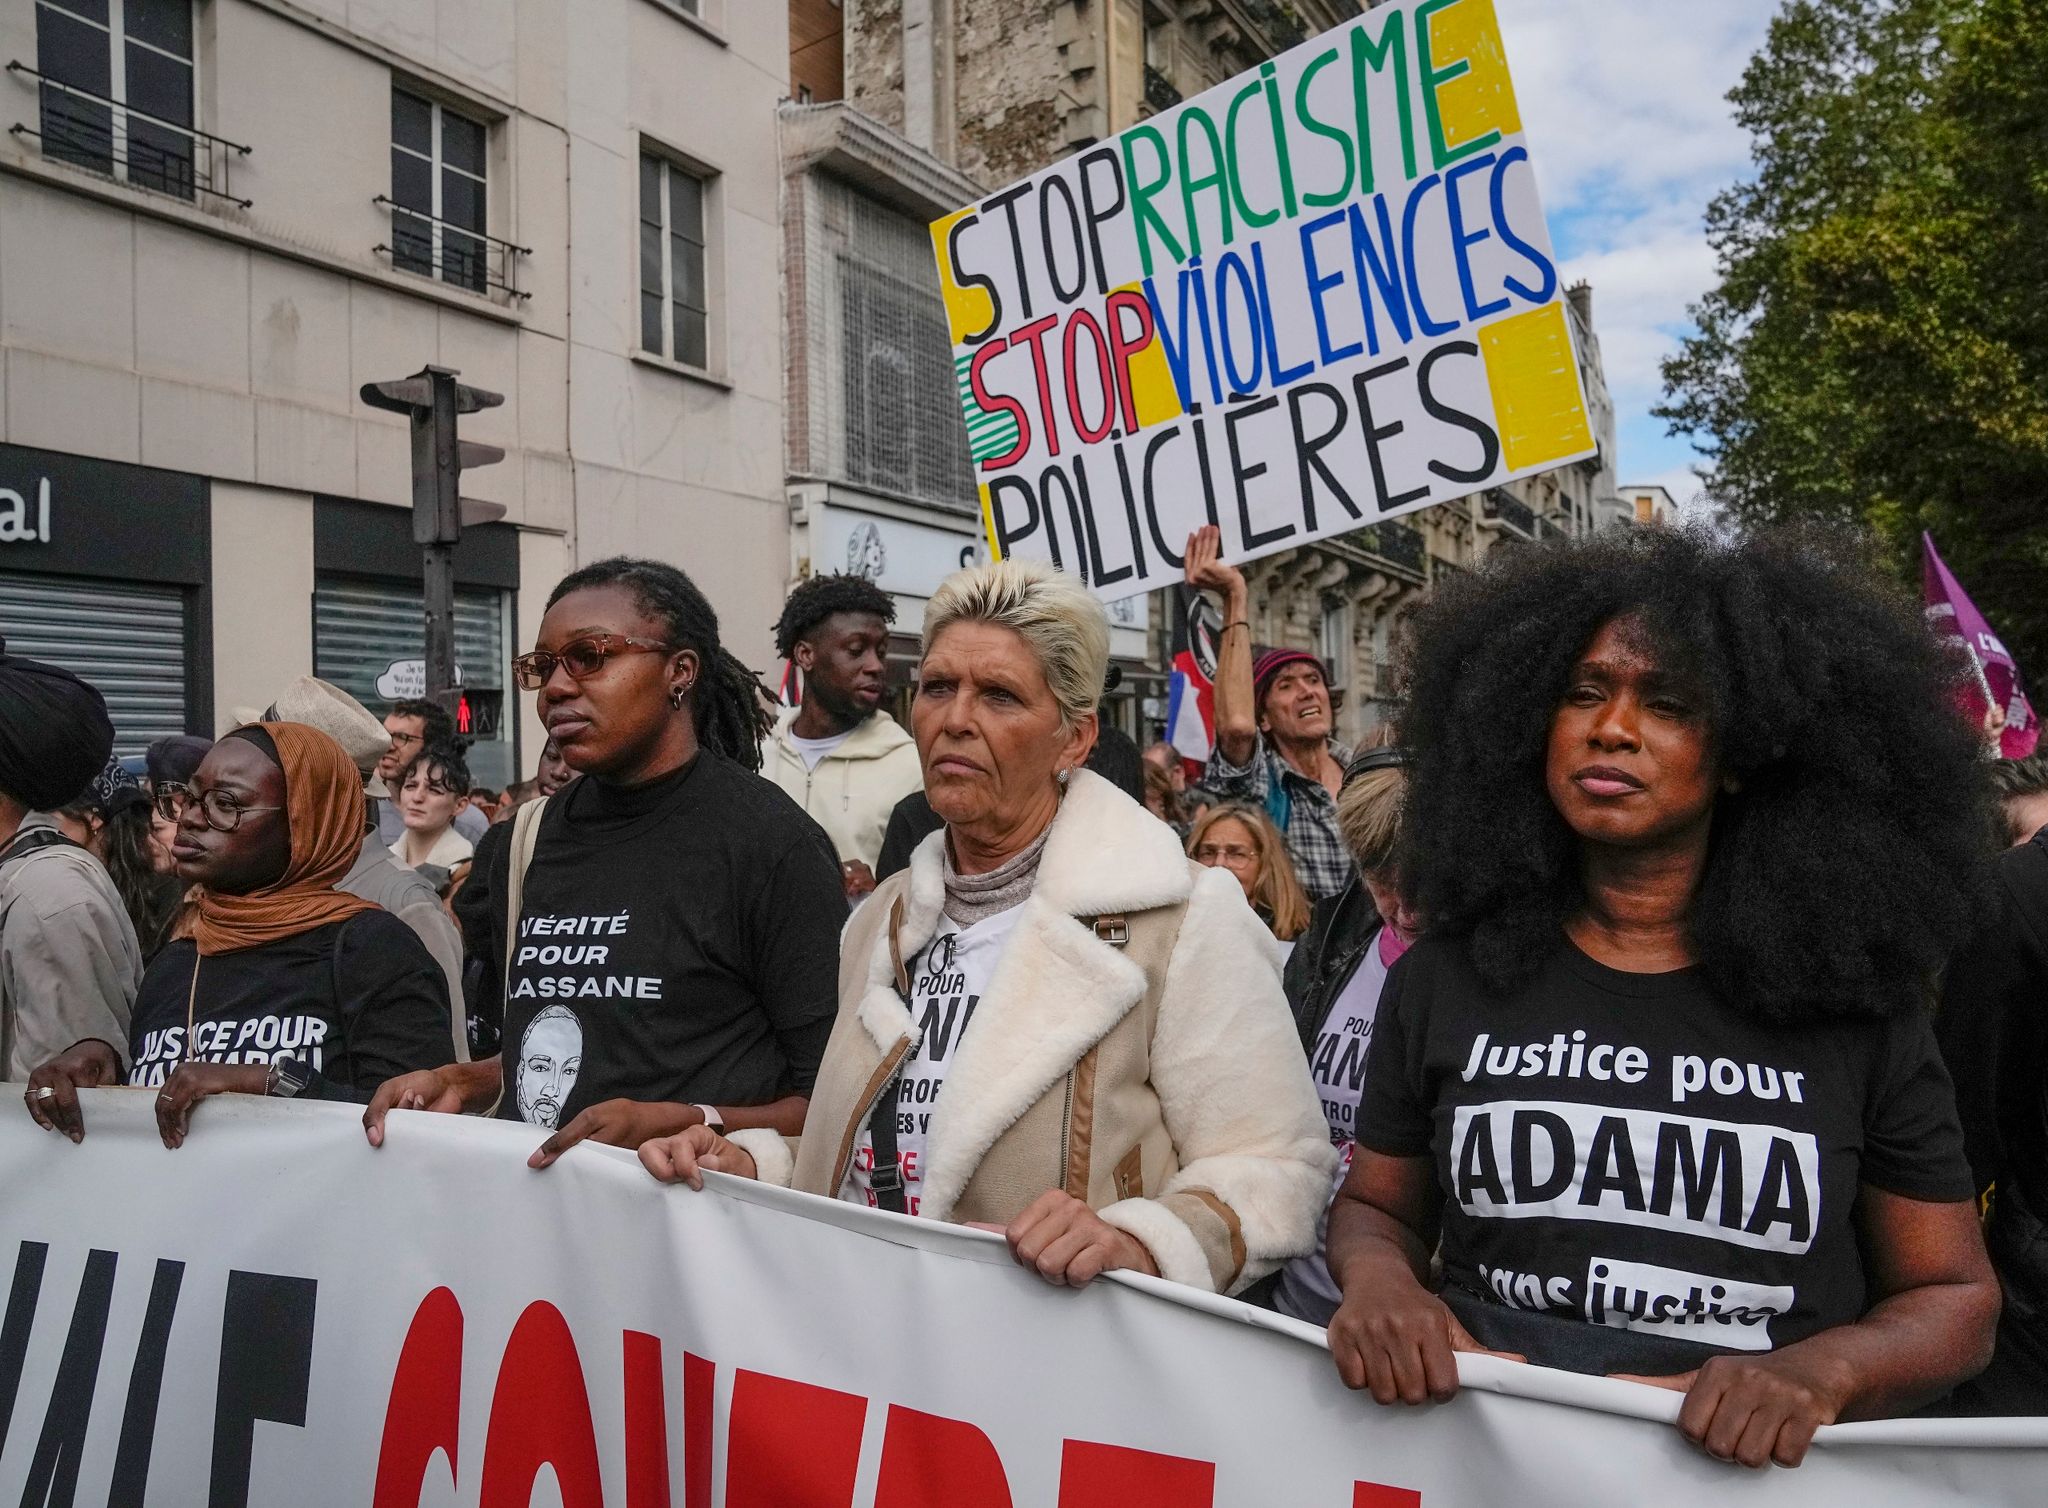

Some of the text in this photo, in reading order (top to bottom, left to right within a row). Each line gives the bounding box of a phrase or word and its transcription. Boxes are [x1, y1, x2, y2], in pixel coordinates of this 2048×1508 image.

[950, 0, 1502, 345] STOP RACISME
[968, 146, 1557, 471] STOP VIOLENCES
[521, 909, 630, 938] VÉRITÉ
[517, 946, 609, 966] POUR
[917, 973, 965, 997] POUR
[136, 1015, 328, 1066] JUSICE POUR
[1343, 1017, 1374, 1037] POU
[1461, 1030, 1805, 1104] Justice pour
[1457, 1109, 1809, 1243] ADAMA
